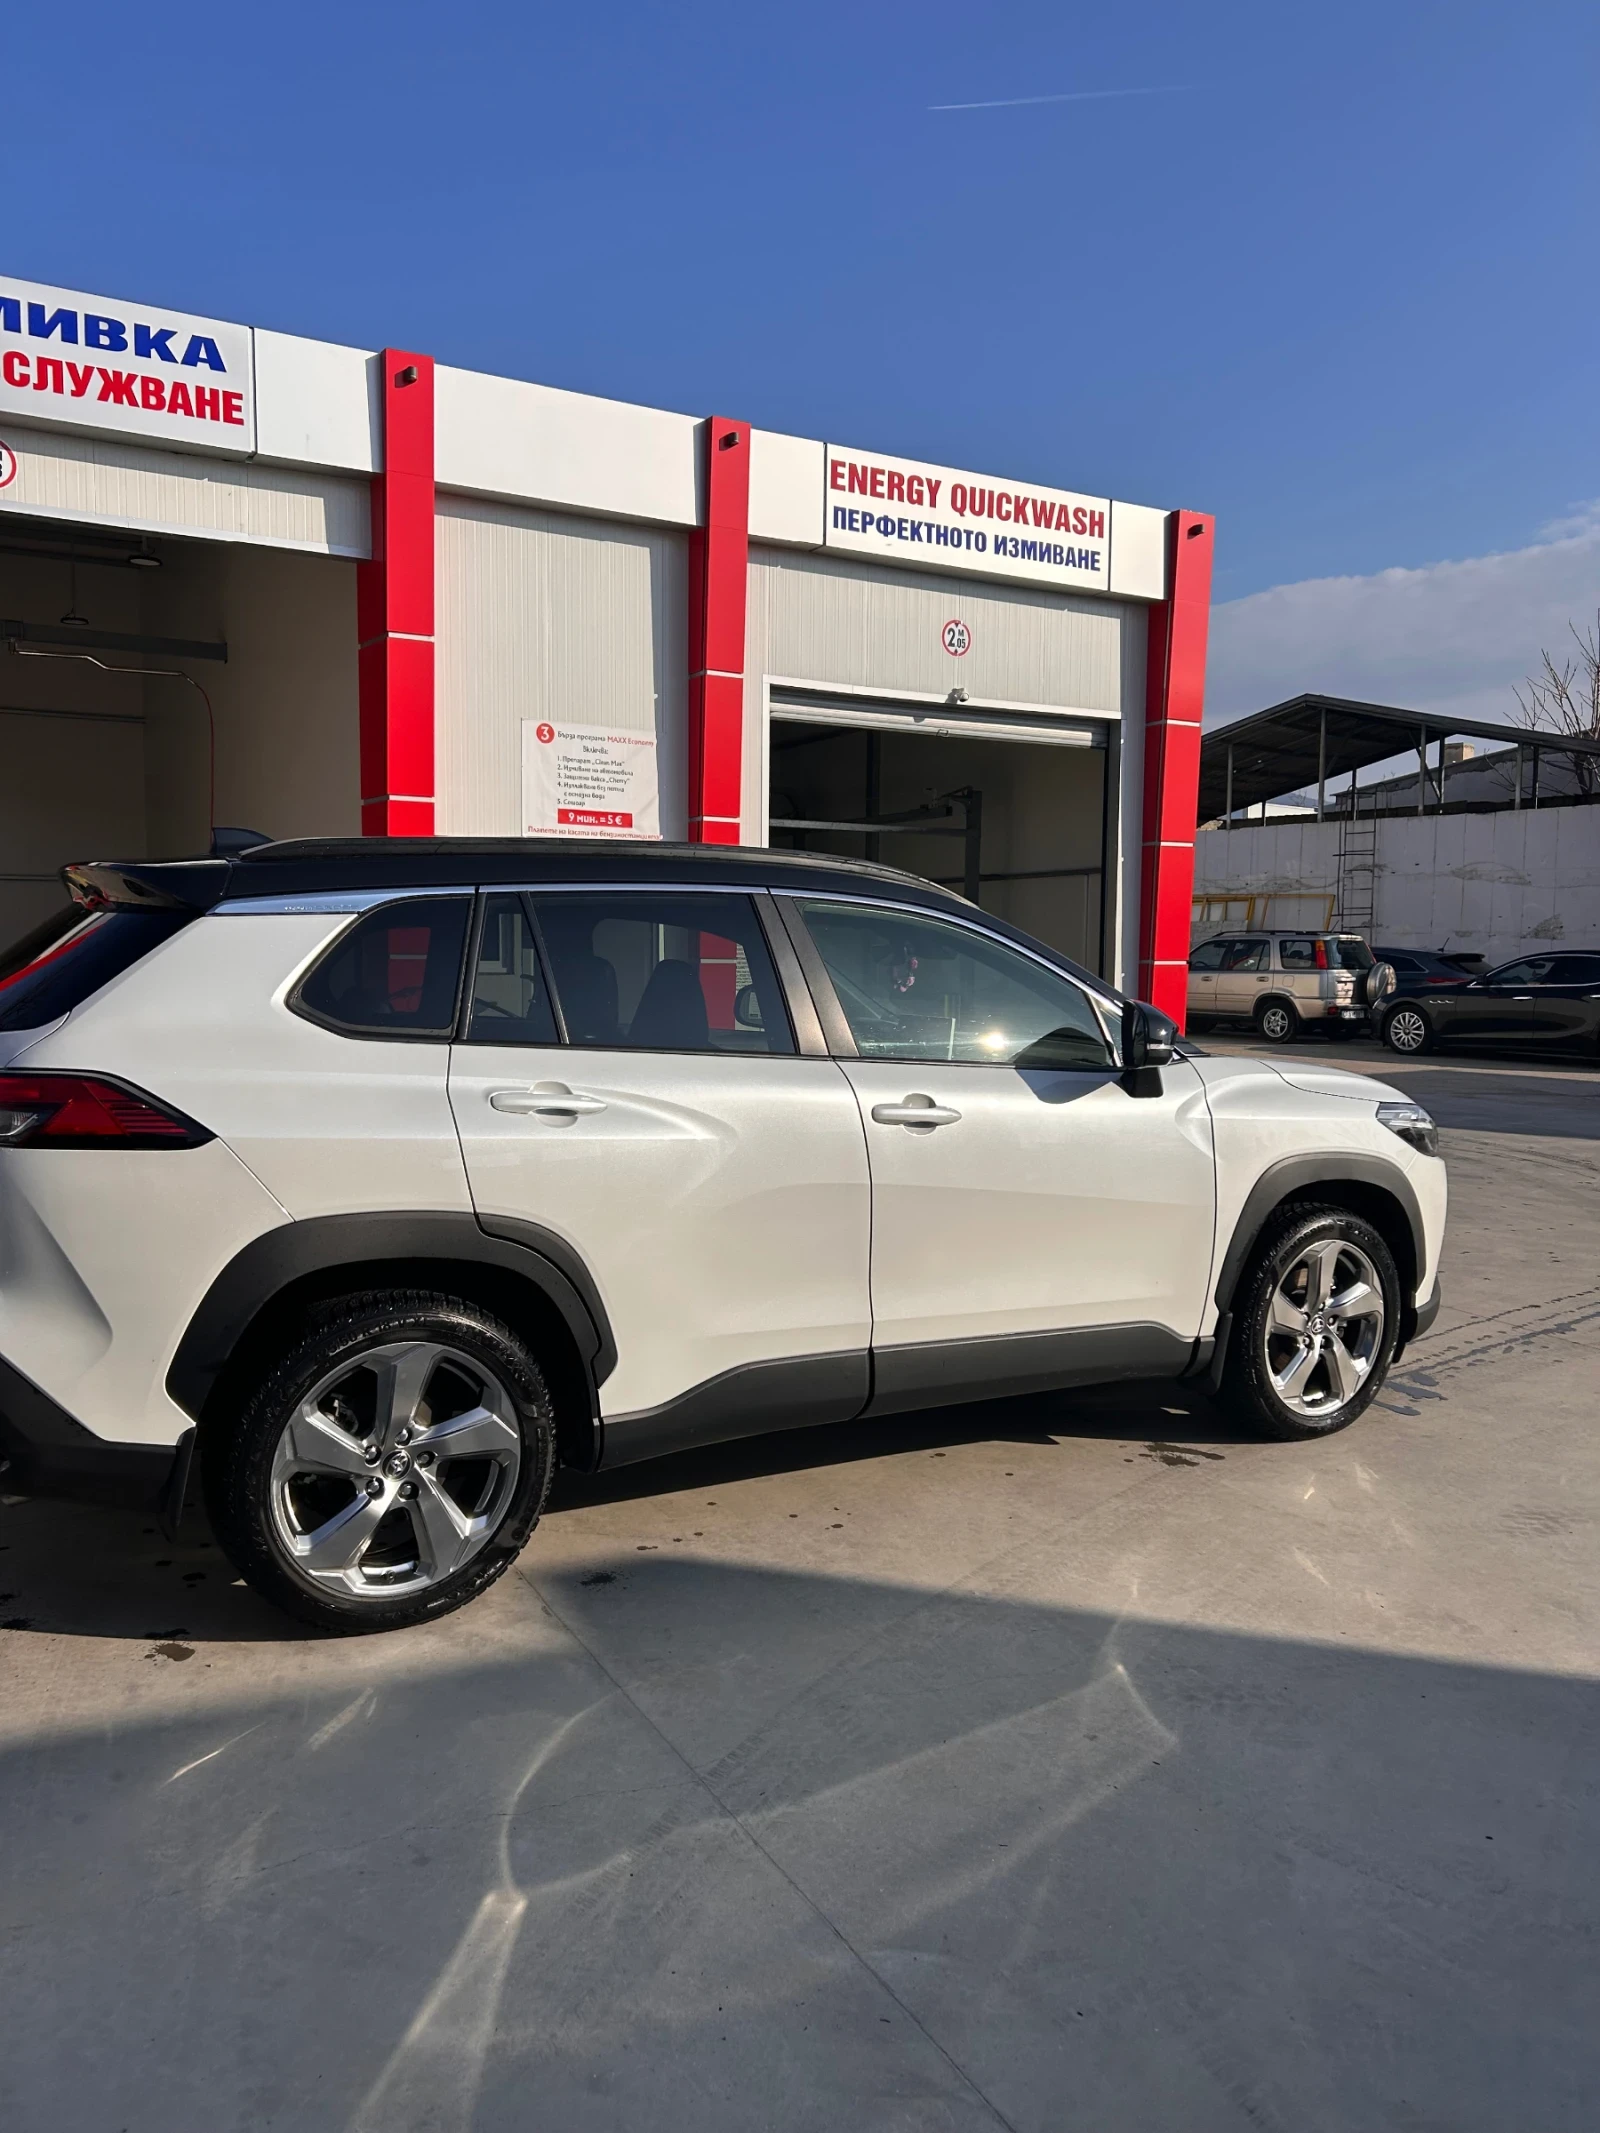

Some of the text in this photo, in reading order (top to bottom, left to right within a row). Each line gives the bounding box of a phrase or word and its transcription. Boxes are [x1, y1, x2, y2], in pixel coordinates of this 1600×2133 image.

[830, 459, 1104, 539] ENERGY QUICKWASH
[832, 505, 1101, 572] ПЕРФЕКТНОТО ИЗМИВАНЕ
[947, 627, 956, 648] 2
[540, 726, 549, 741] 3
[557, 730, 654, 748] Бърза програма MAXX Economy
[562, 755, 591, 765] Препарат
[557, 763, 563, 771] 2.
[600, 767, 634, 776] автомобила
[590, 775, 605, 783] вакса
[597, 784, 606, 792] без
[563, 798, 586, 807] Сешоар
[568, 811, 575, 822] 9
[576, 814, 598, 824] мин.
[607, 814, 614, 825] 5
[615, 815, 623, 826] €
[527, 825, 558, 835] Платете
[567, 828, 590, 837] касата
